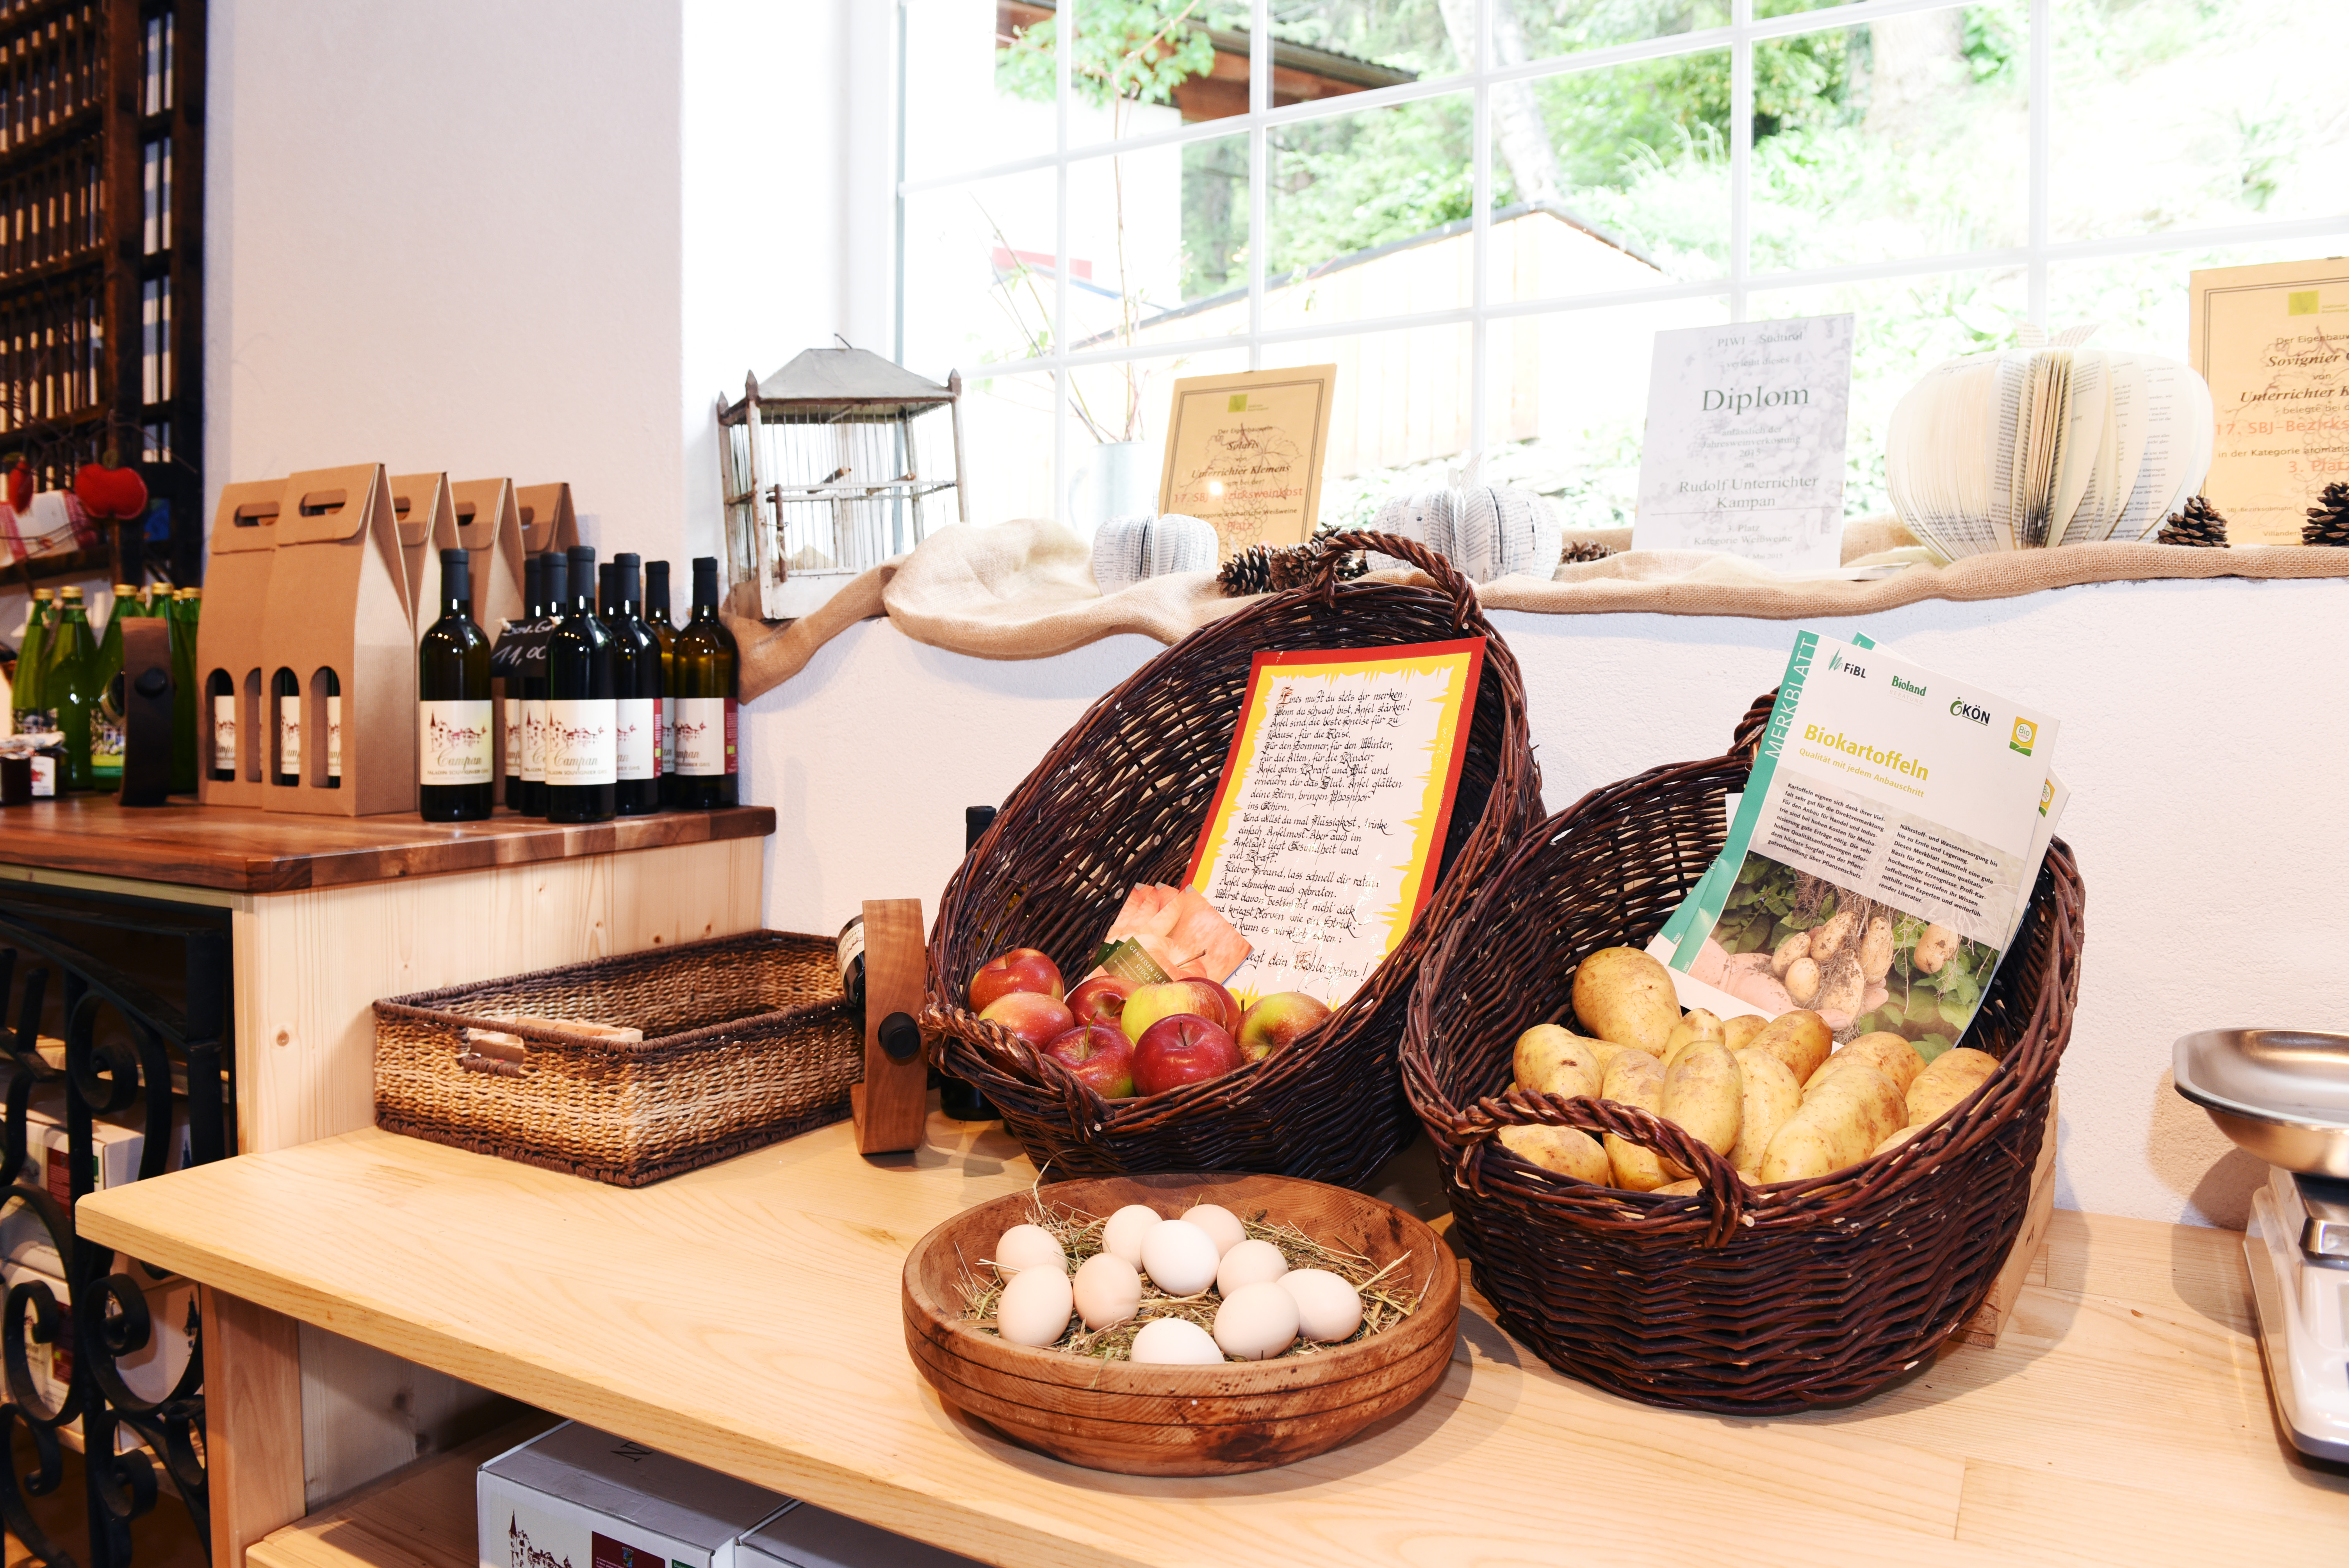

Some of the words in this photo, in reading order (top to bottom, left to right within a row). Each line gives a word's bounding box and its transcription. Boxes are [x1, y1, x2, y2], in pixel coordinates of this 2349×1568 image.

[1718, 337, 1745, 347] PIWI
[1759, 331, 1803, 343] Südtirol
[1763, 357, 1790, 365] dieses
[2268, 353, 2340, 367] Sovignier
[1702, 386, 1809, 415] Diplom
[2241, 388, 2335, 402] Unterrichter
[2283, 406, 2321, 414] belegte
[2216, 424, 2241, 435] 17.
[1702, 436, 1800, 449] Jahresweinverkostung
[1739, 449, 1761, 457] 2015
[2251, 447, 2300, 457] Kategorie
[1192, 467, 1248, 478] Unterrichter
[1250, 465, 1291, 474] Klemens
[2288, 461, 2304, 473] 3.
[1679, 479, 1729, 492] Rudolf
[1732, 476, 1819, 490] Unterrichter
[1718, 497, 1775, 510] Kampan
[1227, 521, 1253, 531] Platz
[1741, 535, 1792, 543] Weißweine
[1843, 663, 1866, 679] FiBL
[1891, 675, 1927, 697] Bioland
[1326, 691, 1335, 702] du
[1338, 690, 1355, 702] stets
[1358, 689, 1370, 701] dir
[1764, 637, 1818, 759] MERKBLATT
[1889, 689, 1924, 705] BERATUNG
[1296, 706, 1306, 716] du
[1307, 706, 1335, 718] schwach
[1337, 705, 1353, 716] bist,
[1290, 716, 1306, 727] sind
[1308, 716, 1320, 727] die
[1322, 716, 1341, 726] beste
[1371, 715, 1386, 730] für
[2018, 725, 2031, 737] Bio
[1298, 728, 1311, 741] für
[1314, 729, 1325, 738] die
[1326, 728, 1351, 740] Reise.
[437, 747, 482, 771] Campan
[554, 747, 598, 771] Campan
[1804, 723, 1928, 780] Biokartoffeln
[1799, 748, 1831, 764] Qualität
[1832, 760, 1846, 769] mit
[1846, 765, 1872, 778] jedem
[1873, 774, 1924, 798] Anbauschritt
[1787, 782, 1813, 796] Kartoffeln
[1814, 793, 1832, 803] eignen
[1845, 804, 1858, 812] dank
[1859, 809, 1872, 817] ihrer
[1802, 807, 1819, 816] Anbau
[1829, 816, 1848, 827] Handel
[1860, 828, 1877, 837] Indus-
[1835, 809, 1885, 832] Direktvermarktung.
[1773, 822, 1790, 832] hohen
[1791, 829, 1851, 856] Qualitätsanforderungen
[1776, 816, 1800, 829] nisierung
[1813, 829, 1832, 839] Erträge
[1833, 837, 1848, 846] nötig.
[1811, 818, 1827, 829] hohen
[1828, 825, 1846, 836] Kosten
[1856, 836, 1876, 846] Mecha-
[1783, 835, 1804, 847] höchste
[1804, 843, 1825, 855] Sorgfalt
[1846, 860, 1865, 870] Pflanz-
[1900, 823, 1927, 837] Nährstoff-
[1940, 839, 1989, 864] Wasserversorgung
[1989, 859, 1998, 867] bis
[1914, 839, 1929, 848] Ernte
[1942, 849, 1968, 865] Lagerung.
[1767, 839, 1808, 859] gutvorbereitung
[1809, 854, 1821, 863] über
[1821, 859, 1862, 880] Pflanzenschutz,
[1891, 848, 1905, 858] Basis
[1925, 862, 1956, 878] Produktion
[1957, 876, 1983, 889] qualitativ
[1893, 840, 1912, 851] Dieses
[1913, 848, 1940, 862] Merkblatt
[1941, 859, 1967, 873] vermittelt
[1968, 870, 1980, 878] eine
[1980, 876, 1993, 884] gute
[1884, 865, 1922, 884] toffelbetriebe
[1923, 881, 1948, 894] vertiefen
[1958, 894, 1978, 906] Wissen
[1887, 857, 1924, 875] hochwertiger
[1924, 871, 1958, 889] Erzeugnisse.
[1959, 885, 1986, 899] Profi-Kar-
[1878, 883, 1897, 893] render
[1897, 889, 1922, 903] Literatur.
[1881, 875, 1903, 886] mithilfe
[1915, 887, 1940, 900] Experten
[1953, 903, 1982, 917] weiterfüh-
[1672, 932, 1681, 943] 2007
[1130, 945, 1155, 972] GENIESSEN
[1153, 972, 1162, 981] SIE
[1682, 961, 1691, 972] 2007
[1135, 964, 1151, 982] STÜCK
